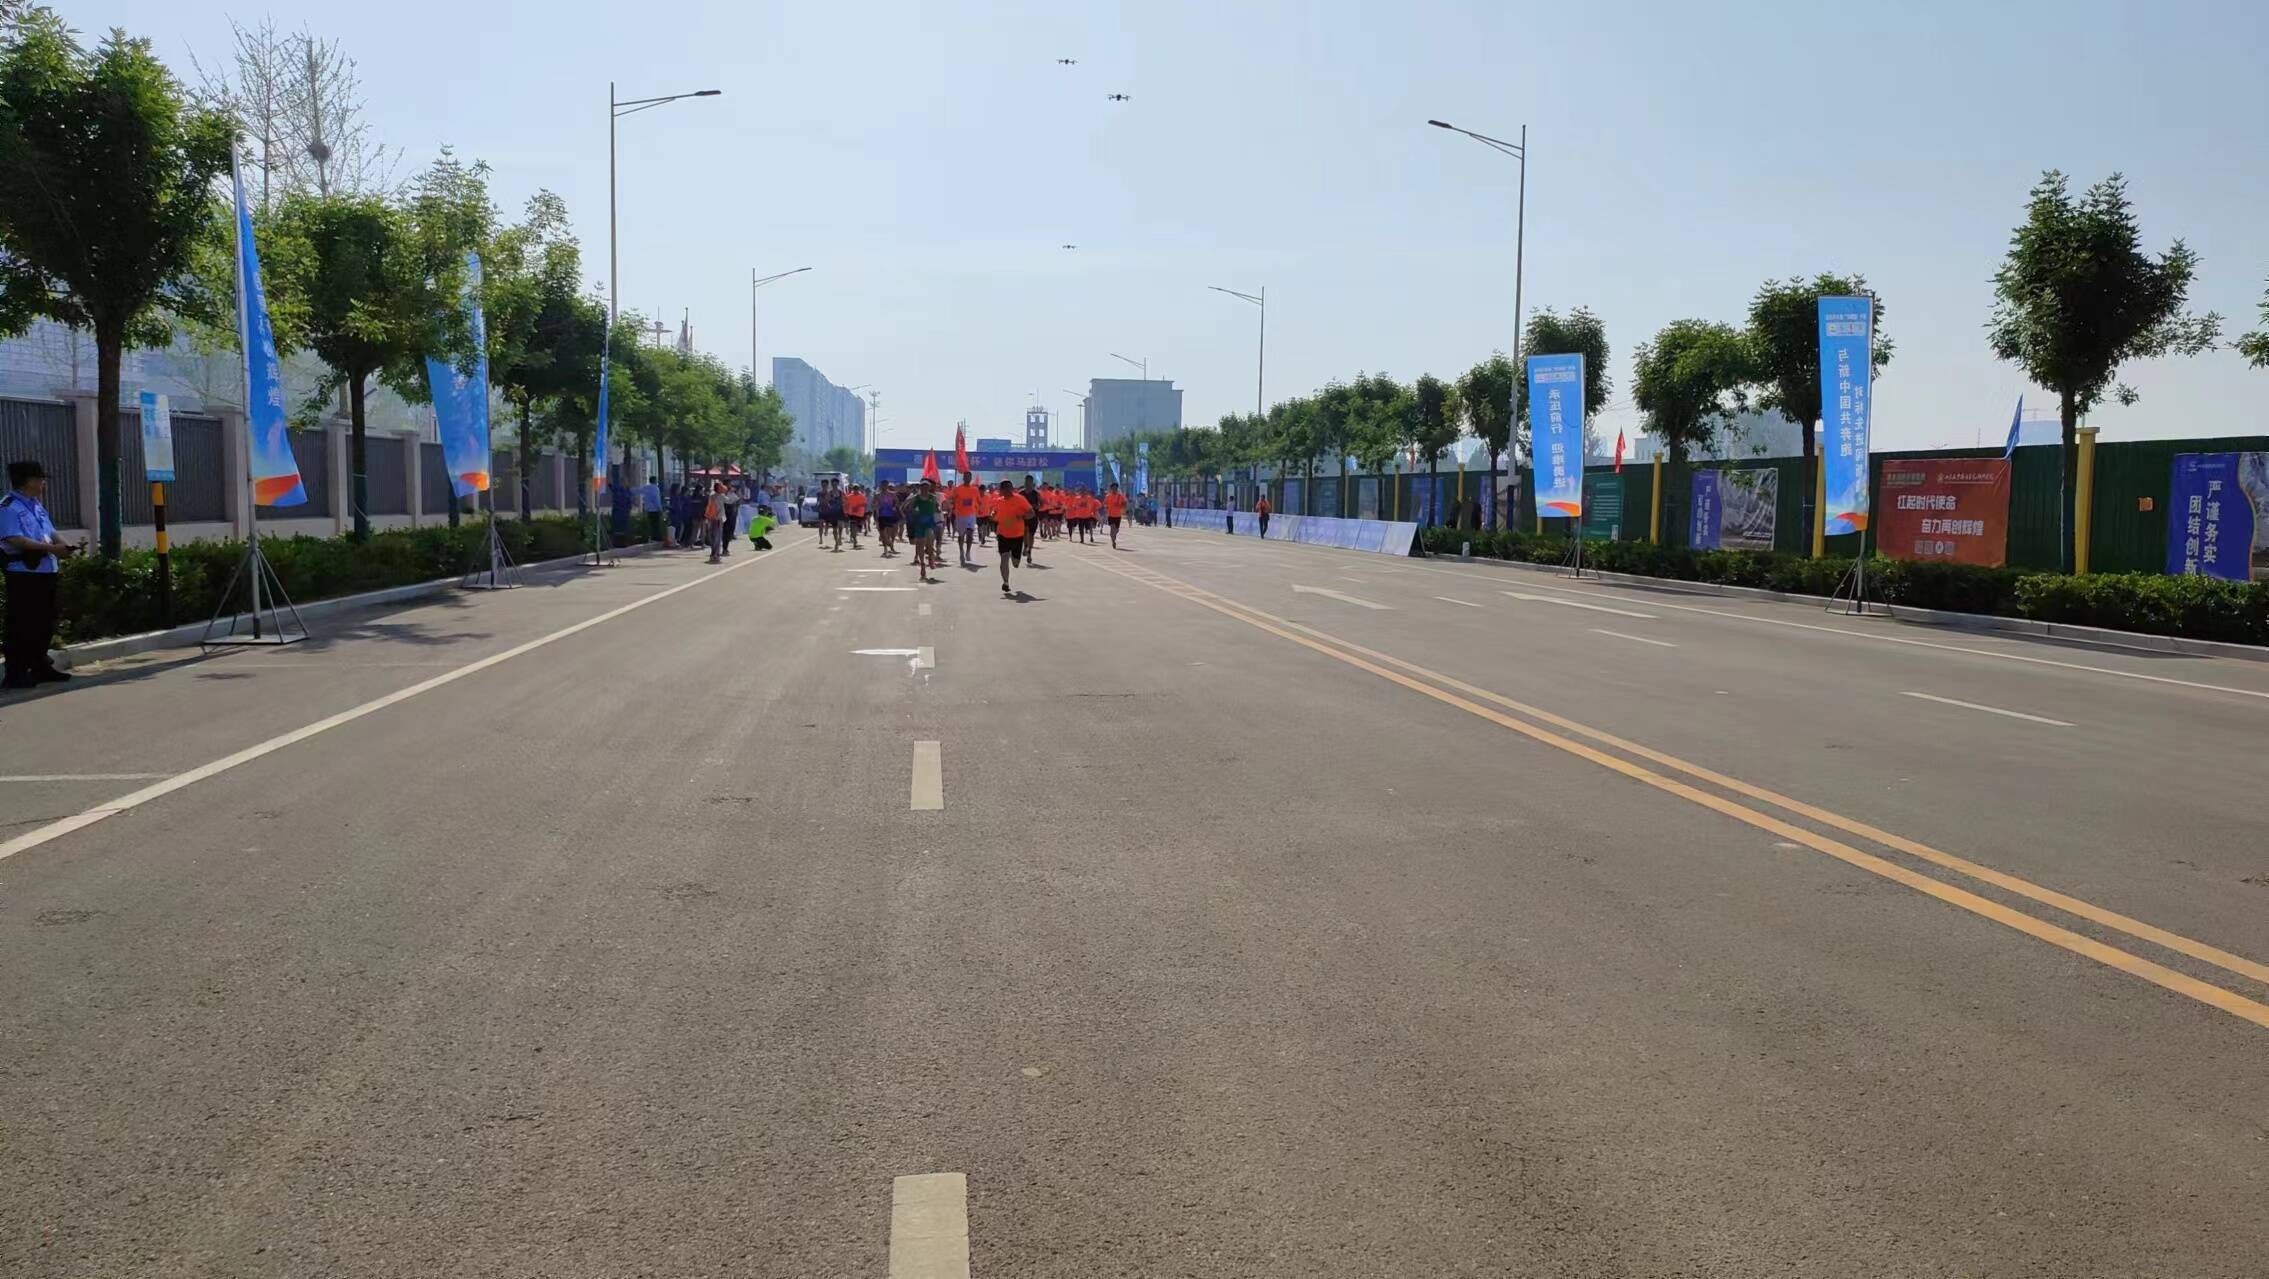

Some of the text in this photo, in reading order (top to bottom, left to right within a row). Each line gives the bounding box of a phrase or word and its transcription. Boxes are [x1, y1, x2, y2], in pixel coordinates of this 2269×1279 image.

[993, 457, 1049, 468] 迷你马拉松
[1897, 495, 1957, 510] 扛起时代使命
[1921, 518, 1985, 536] 奋力再创辉煌
[2203, 480, 2223, 564] 严谨务实
[2184, 495, 2202, 576] 团结创新
